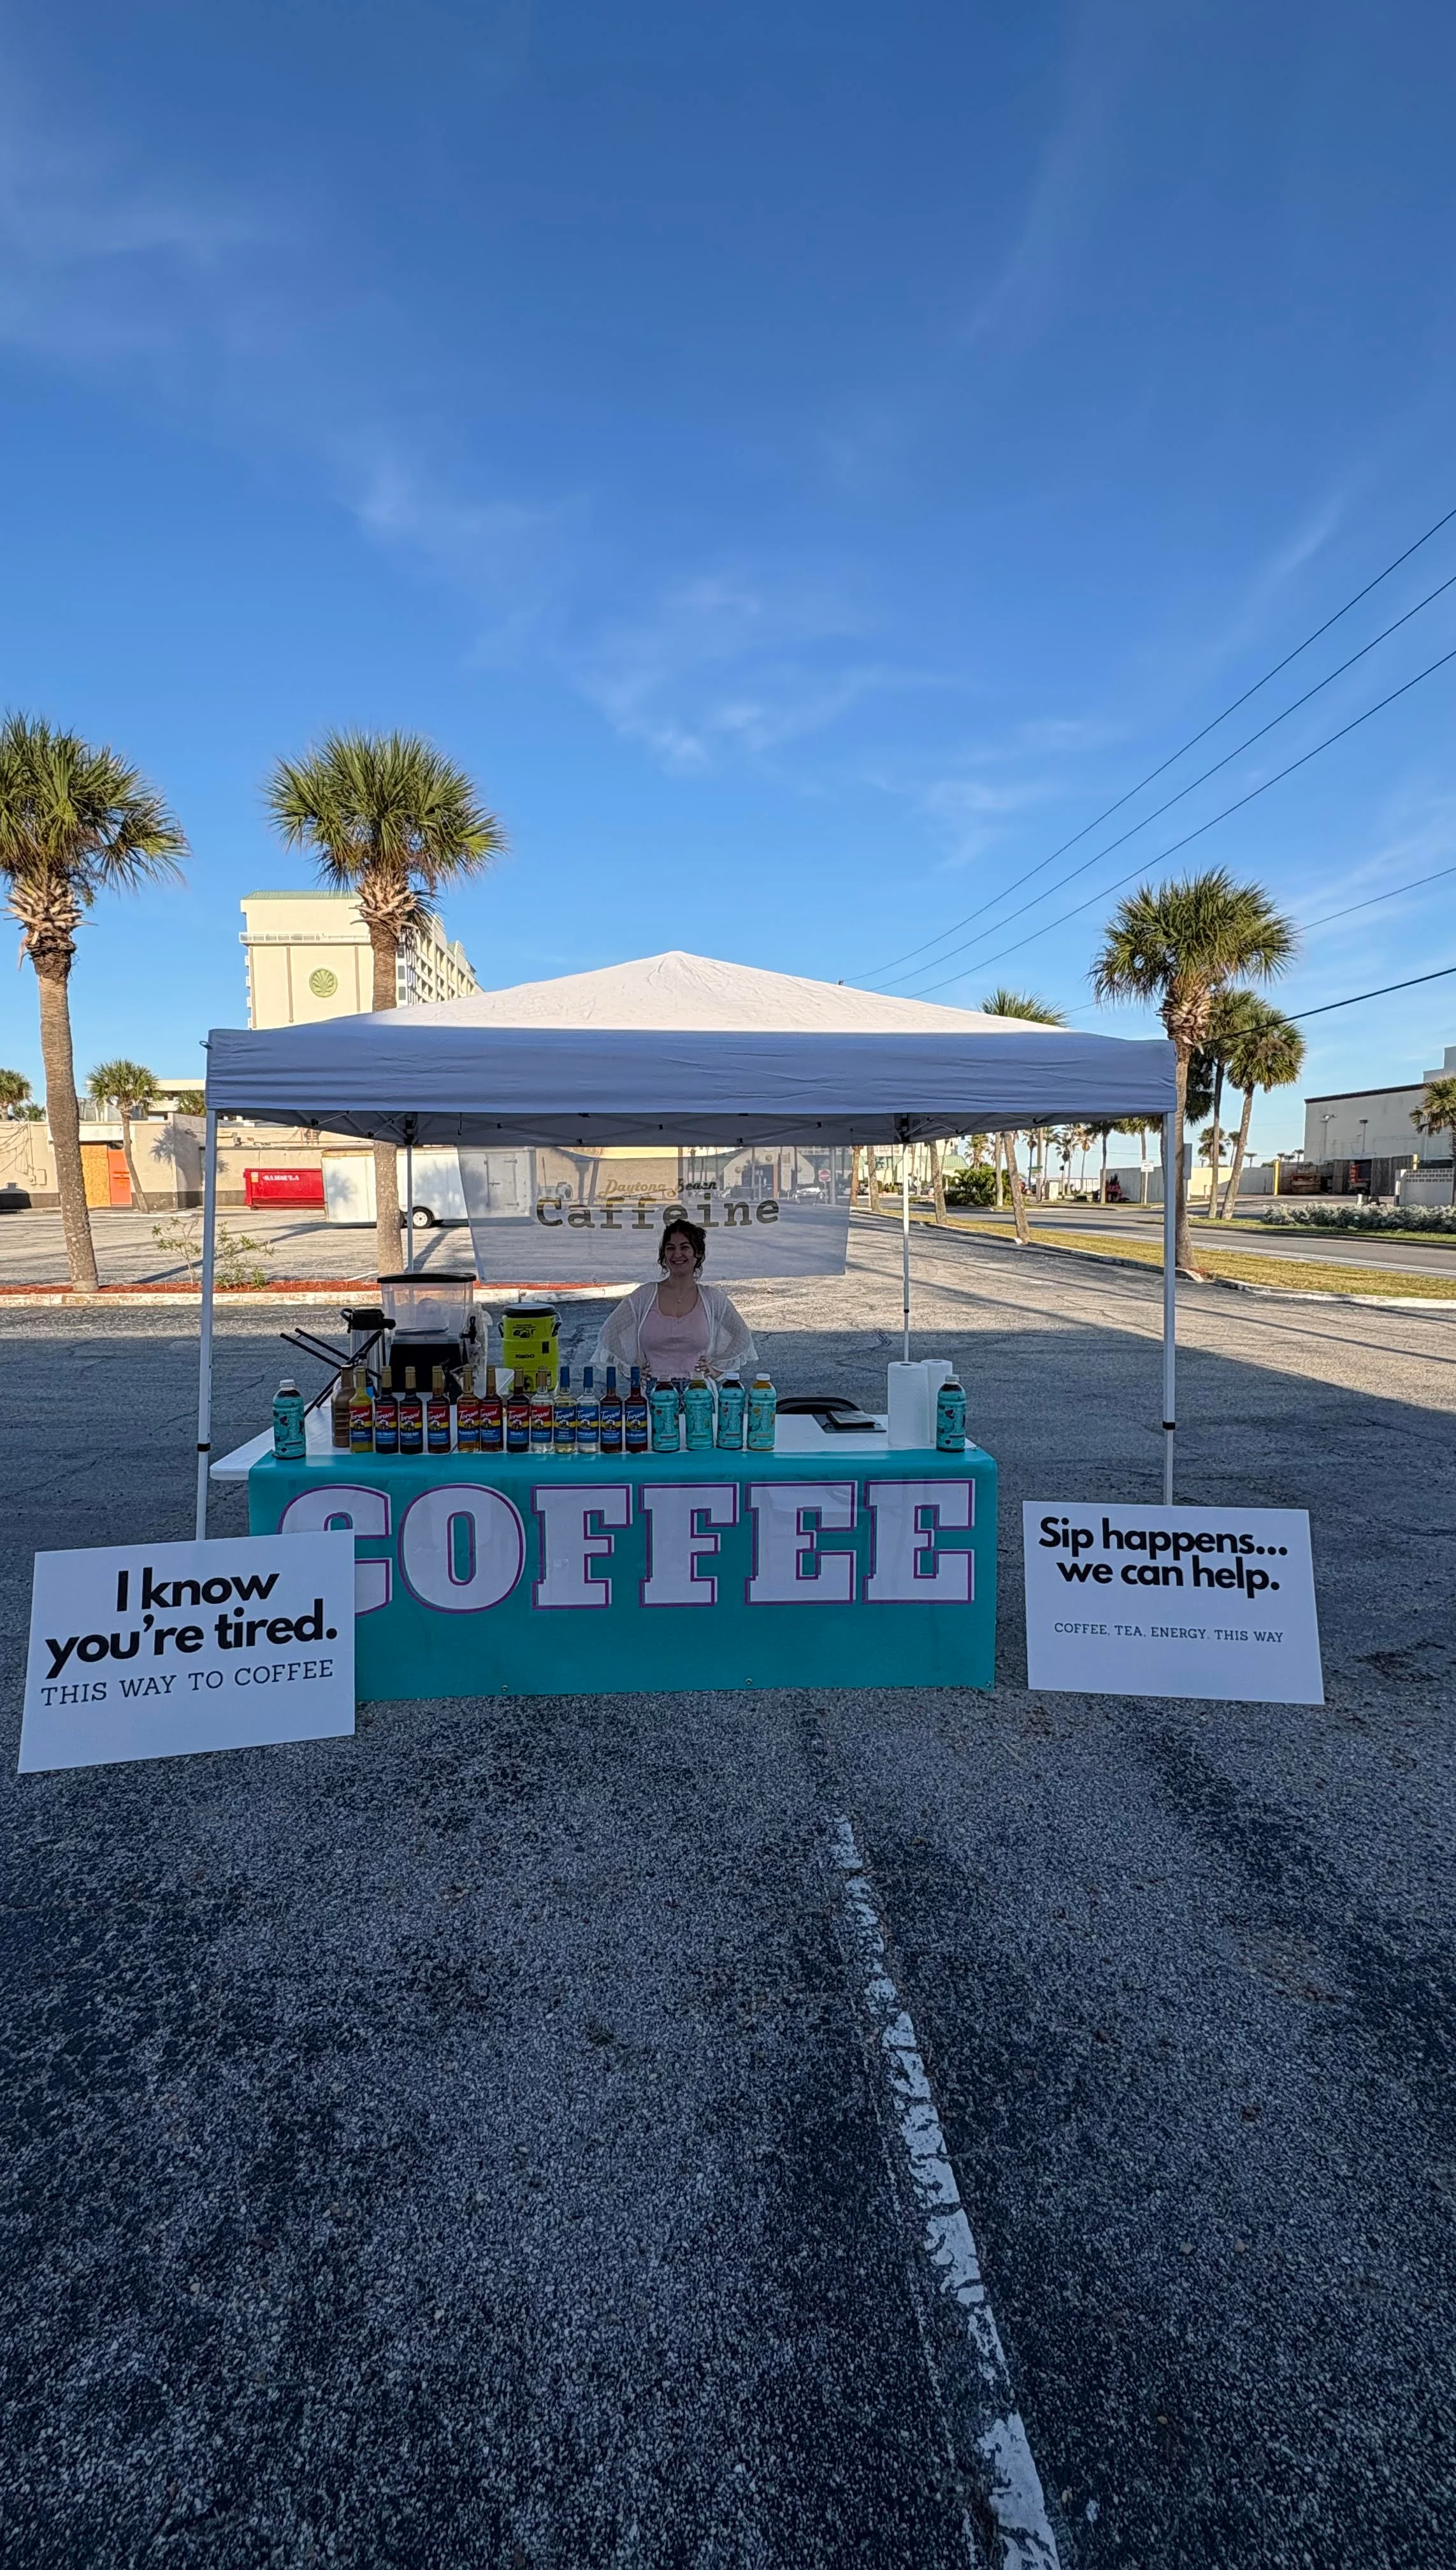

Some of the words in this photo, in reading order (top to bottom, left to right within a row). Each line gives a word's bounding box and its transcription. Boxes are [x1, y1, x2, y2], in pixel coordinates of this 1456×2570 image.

[598, 1179, 666, 1196] Daytona
[536, 1193, 779, 1230] Caffeine
[375, 1409, 394, 1421] Torani
[400, 1409, 420, 1421] Torani
[555, 1409, 574, 1421] Torani
[577, 1409, 596, 1419] Torani
[601, 1409, 621, 1421] Torani
[626, 1409, 645, 1421] Torani
[1039, 1516, 1094, 1557] Sip
[1102, 1518, 1288, 1560] happens...
[278, 1479, 976, 1615] COFFEE
[1056, 1562, 1113, 1584] we
[1120, 1564, 1183, 1586] can
[1192, 1555, 1280, 1599] help.
[117, 1571, 129, 1611] I
[141, 1567, 280, 1609] know
[45, 1614, 204, 1679] you're
[214, 1598, 337, 1650] tired.
[1214, 1629, 1248, 1641] THIS
[1253, 1631, 1283, 1643] WAY
[41, 1681, 107, 1706] THIS
[119, 1674, 177, 1698] WAY
[188, 1671, 223, 1691] TO
[234, 1659, 333, 1686] COFFEE
